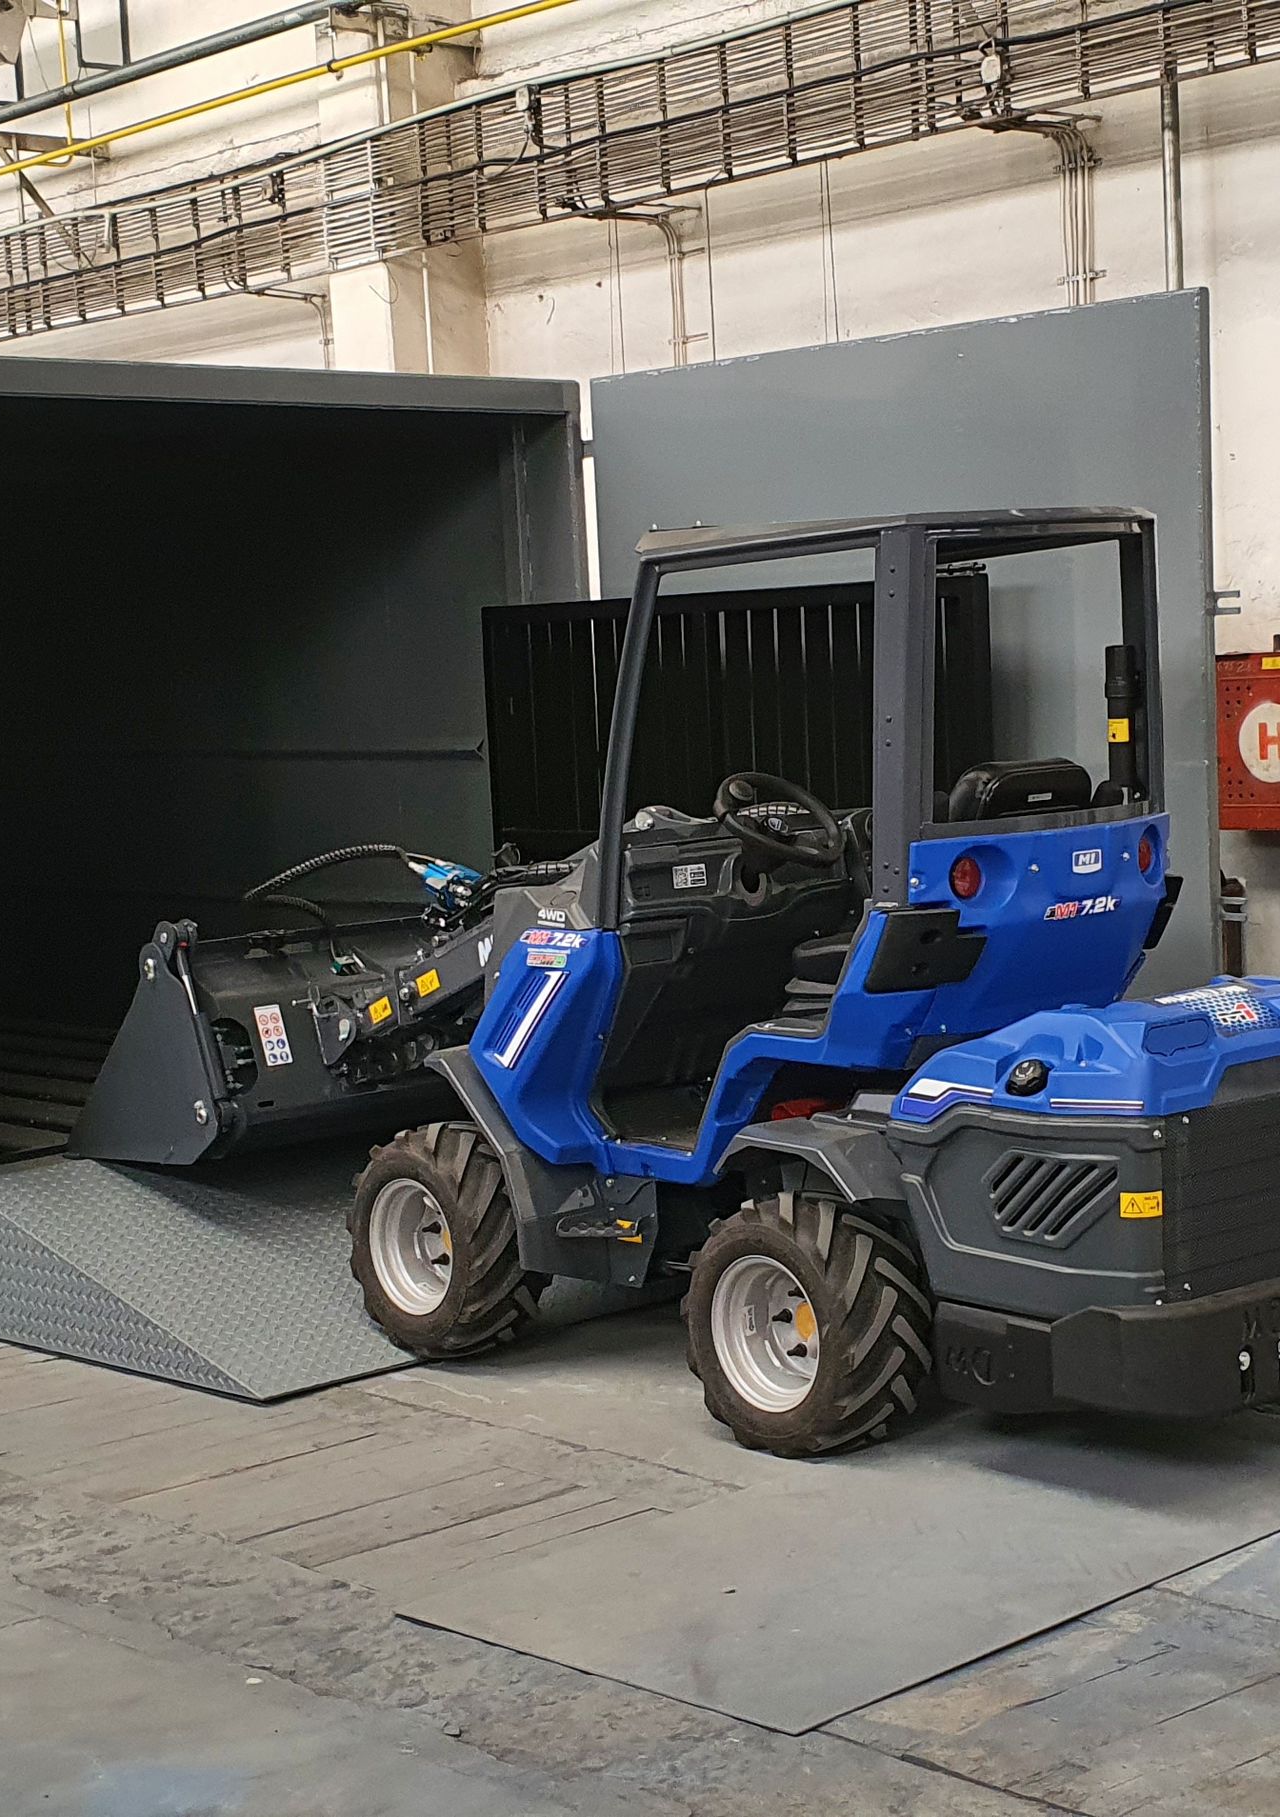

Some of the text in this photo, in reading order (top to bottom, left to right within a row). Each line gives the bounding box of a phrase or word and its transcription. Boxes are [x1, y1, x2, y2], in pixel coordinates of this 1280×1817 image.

[538, 908, 565, 921] 4WD
[1080, 896, 1116, 916] 7.2k
[550, 931, 582, 949] 7.2k
